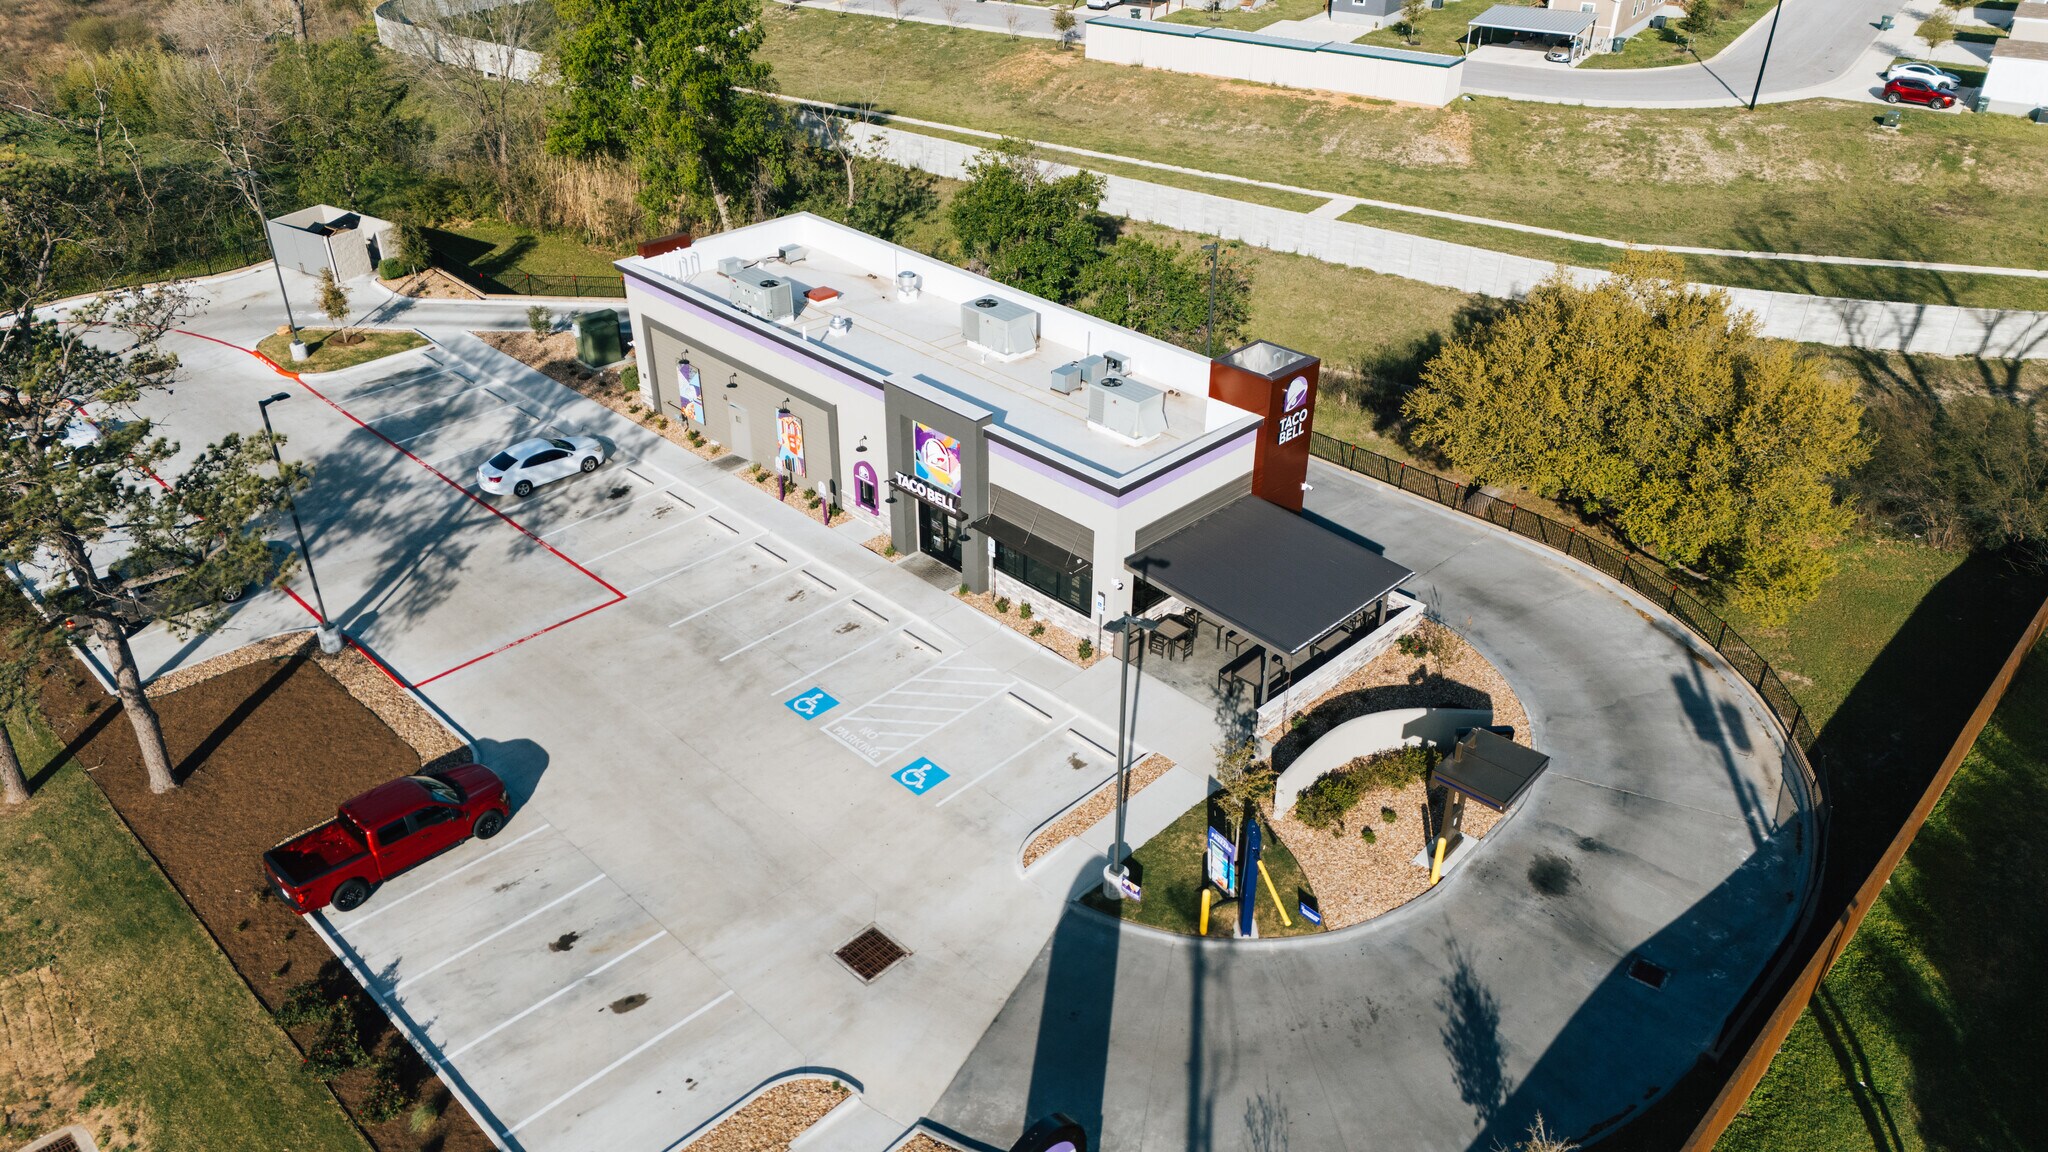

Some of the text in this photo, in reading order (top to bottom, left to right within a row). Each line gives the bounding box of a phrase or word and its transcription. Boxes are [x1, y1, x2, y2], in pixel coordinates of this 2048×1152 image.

[1280, 409, 1308, 432] TACO
[1278, 424, 1304, 446] BELL
[895, 471, 957, 514] TACO BELL
[832, 726, 881, 759] PARKING
[859, 726, 880, 740] NO
